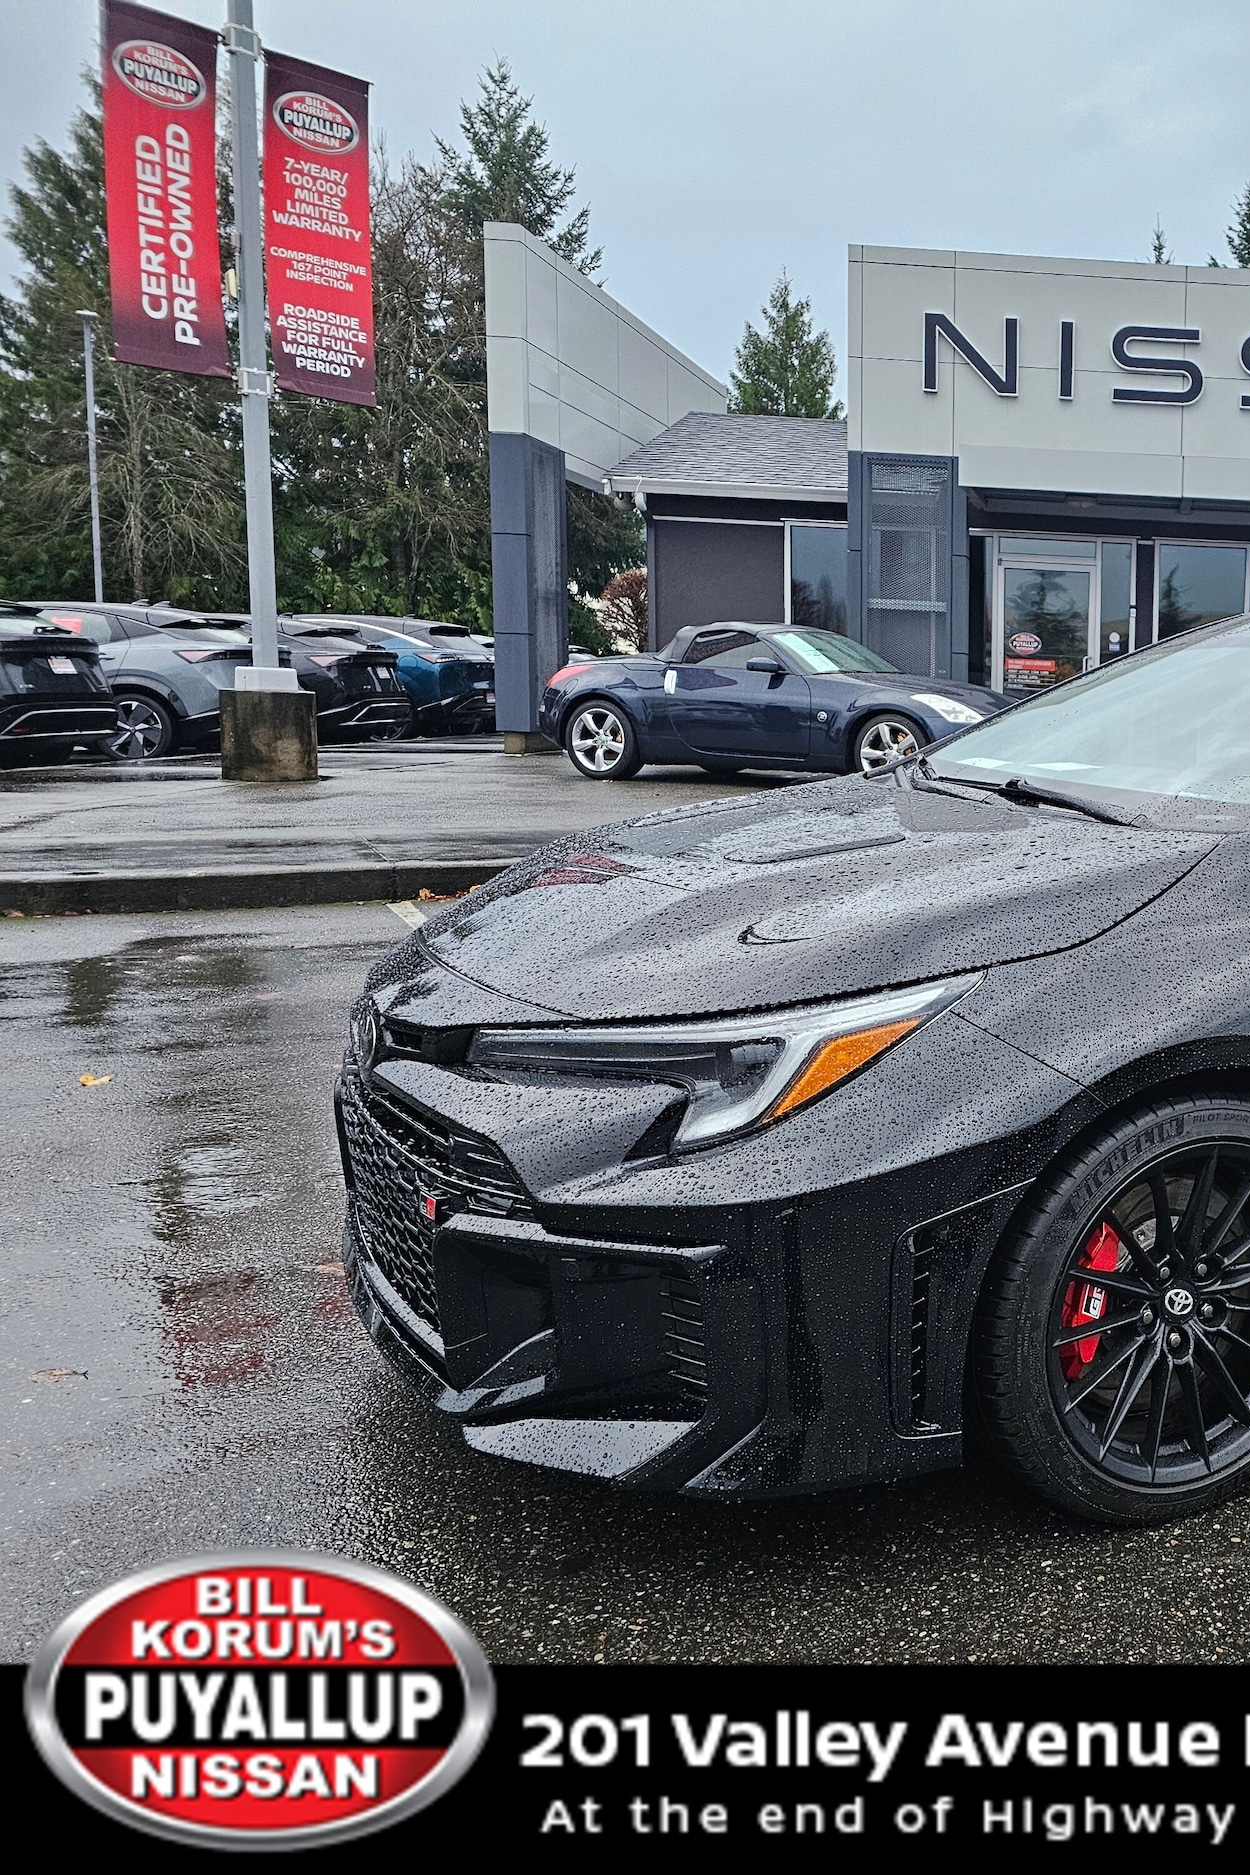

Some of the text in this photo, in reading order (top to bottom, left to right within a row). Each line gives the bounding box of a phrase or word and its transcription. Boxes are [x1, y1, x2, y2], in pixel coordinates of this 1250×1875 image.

[134, 50, 188, 75] KORUM'S
[147, 45, 174, 63] BILL
[123, 58, 198, 94] PUYALLUP
[135, 79, 185, 103] NISSAN
[305, 96, 329, 111] BILL
[283, 108, 351, 140] PUYALLUP
[293, 101, 342, 122] KORUM'S
[293, 127, 339, 148] NISSAN
[284, 156, 349, 185] 7-YEAR/
[294, 187, 342, 210] MILES
[286, 199, 349, 225] LIMITED
[135, 134, 168, 320] CERTIFIED
[165, 123, 201, 346] PRE-OWNED
[272, 210, 362, 242] WARRANTY
[269, 246, 367, 277] COMPREHENSIVE
[291, 260, 349, 281] 167 POINT
[286, 268, 354, 292] INSPECTION
[276, 314, 368, 344] ASSISTANCE
[283, 302, 360, 330] ROADSIDE
[281, 340, 366, 369] WARRANTY
[286, 329, 357, 355] FOR FULL
[295, 356, 352, 378] PERIOD
[1069, 1114, 1184, 1213] MICHELIN
[1193, 1113, 1221, 1124] PILOT
